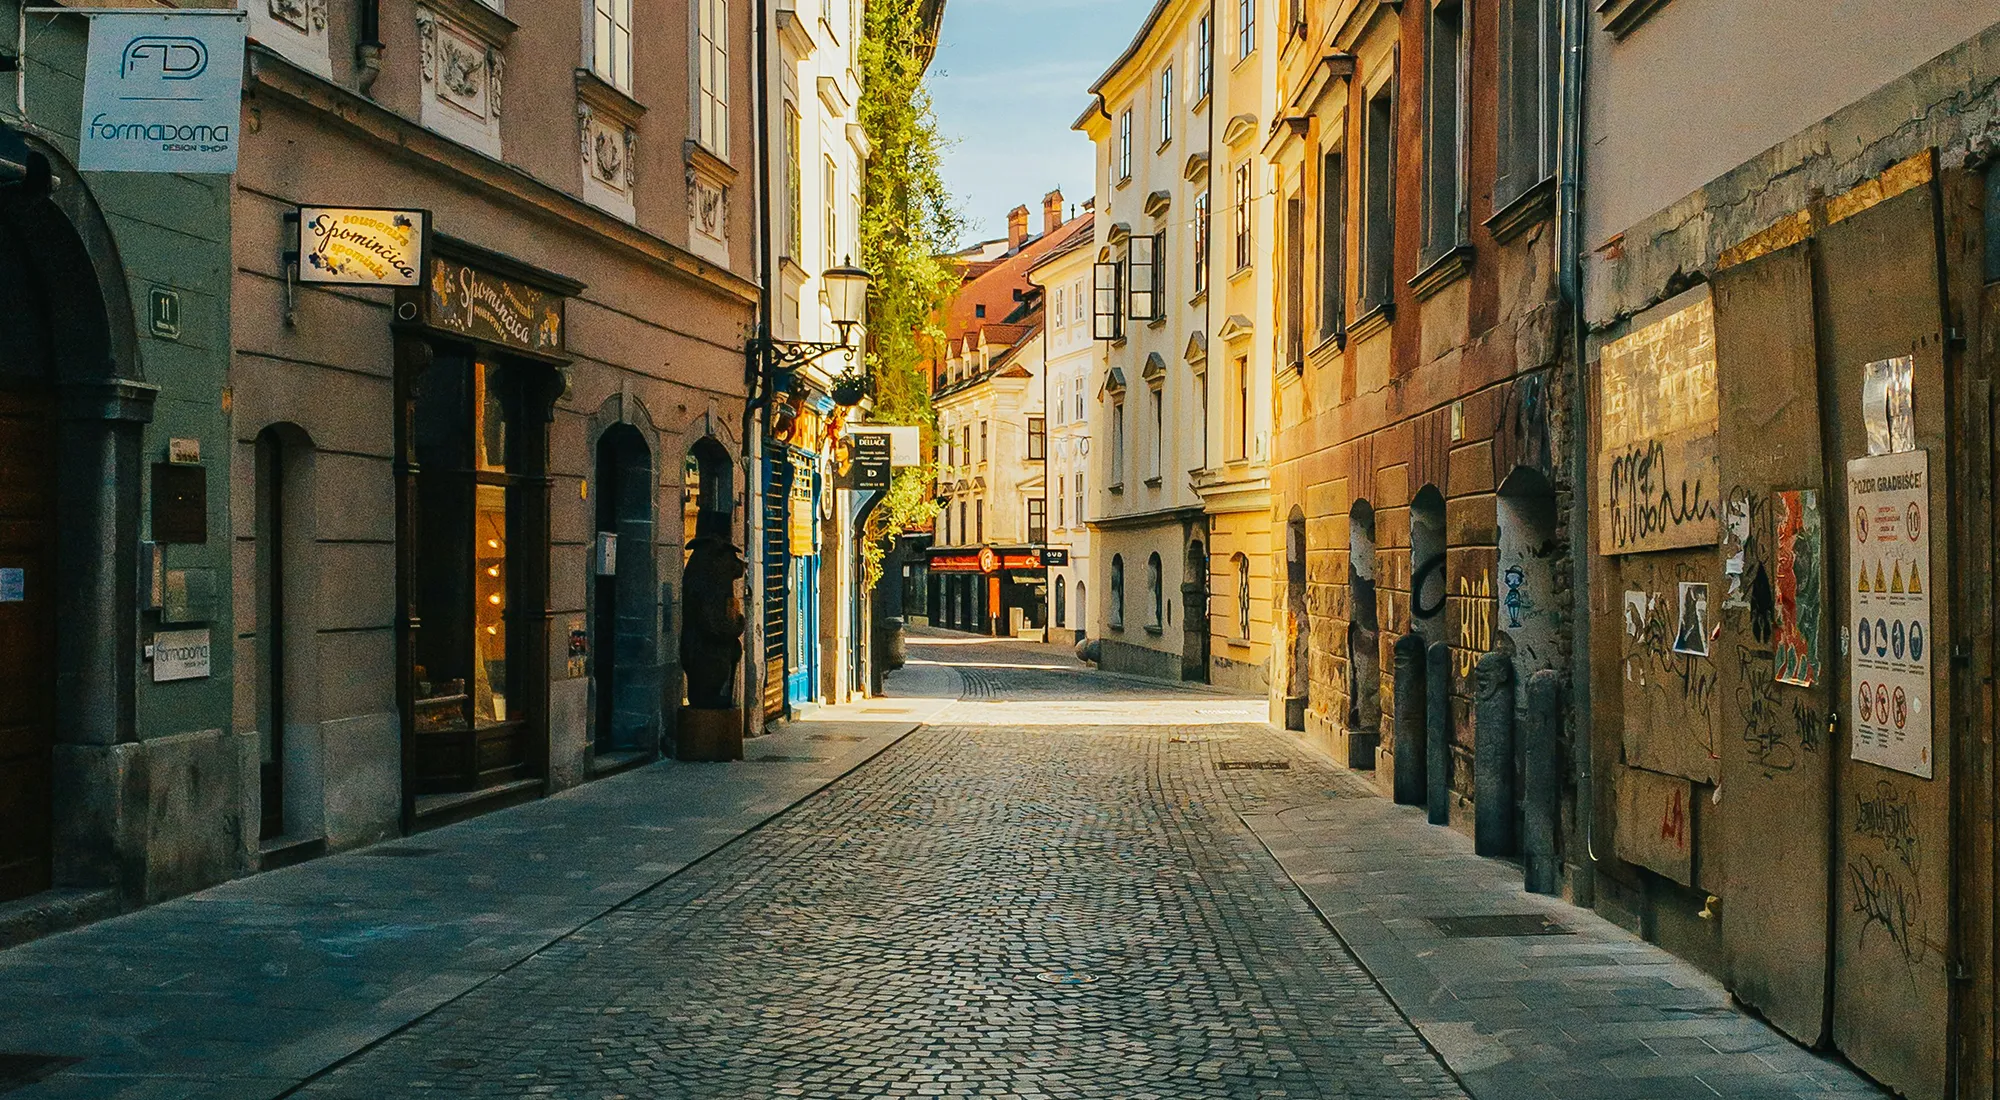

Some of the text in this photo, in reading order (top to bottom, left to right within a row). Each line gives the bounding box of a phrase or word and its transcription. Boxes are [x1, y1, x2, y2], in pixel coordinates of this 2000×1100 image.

[314, 214, 415, 279] Spominčica
[343, 214, 409, 247] souvenirs
[330, 243, 389, 280] spominki
[161, 297, 170, 321] 11
[460, 266, 529, 343] Spominčica
